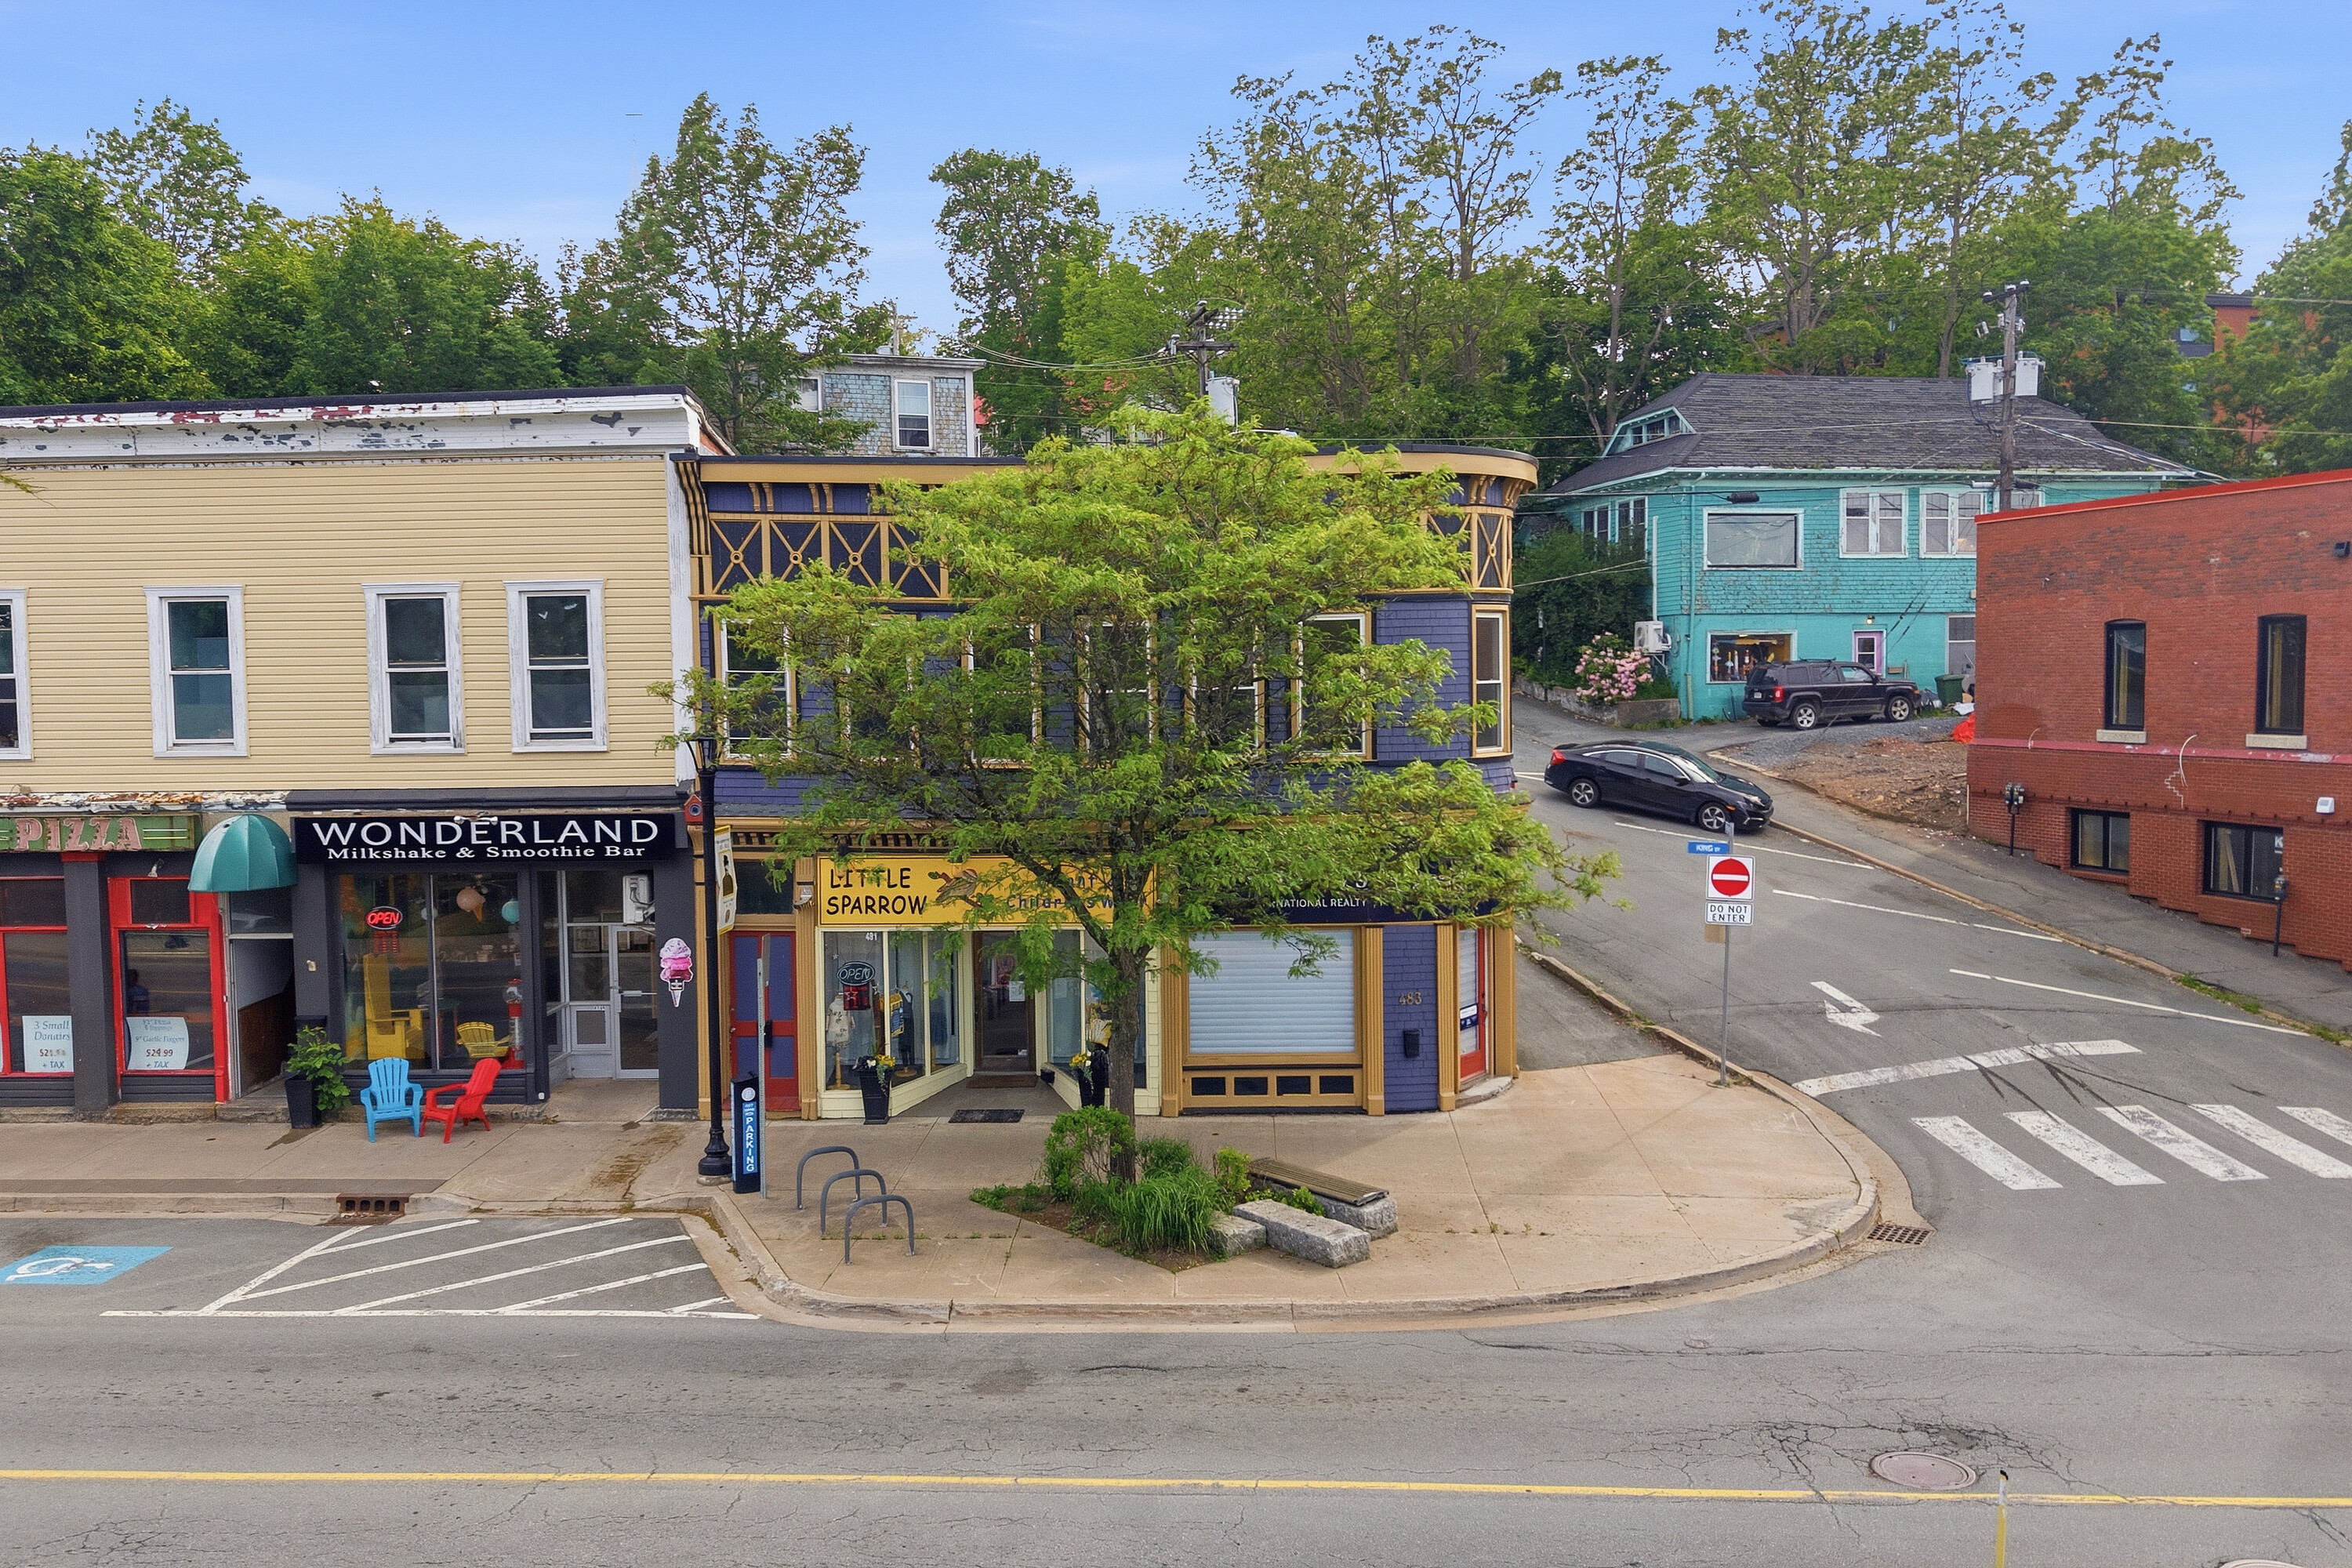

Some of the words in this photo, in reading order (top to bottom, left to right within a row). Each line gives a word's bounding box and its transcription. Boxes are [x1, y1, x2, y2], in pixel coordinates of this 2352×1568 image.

[14, 818, 142, 851] PIZZA
[312, 820, 659, 845] WONDERLAND
[327, 848, 447, 859] Milkshake
[456, 848, 475, 858] &
[486, 846, 595, 858] Smoothie
[604, 845, 645, 856] Bar
[830, 867, 911, 888] LITTLE
[826, 895, 927, 915] SPARROW
[1330, 898, 1367, 907] REALTY
[1728, 906, 1748, 914] NOT
[368, 911, 400, 924] OPEN
[1712, 913, 1745, 923] ENTER
[865, 932, 877, 941] 481
[839, 967, 871, 980] OPEN
[34, 1020, 40, 1029] 3
[42, 1020, 70, 1029] Small
[746, 1116, 755, 1172] PARKING
